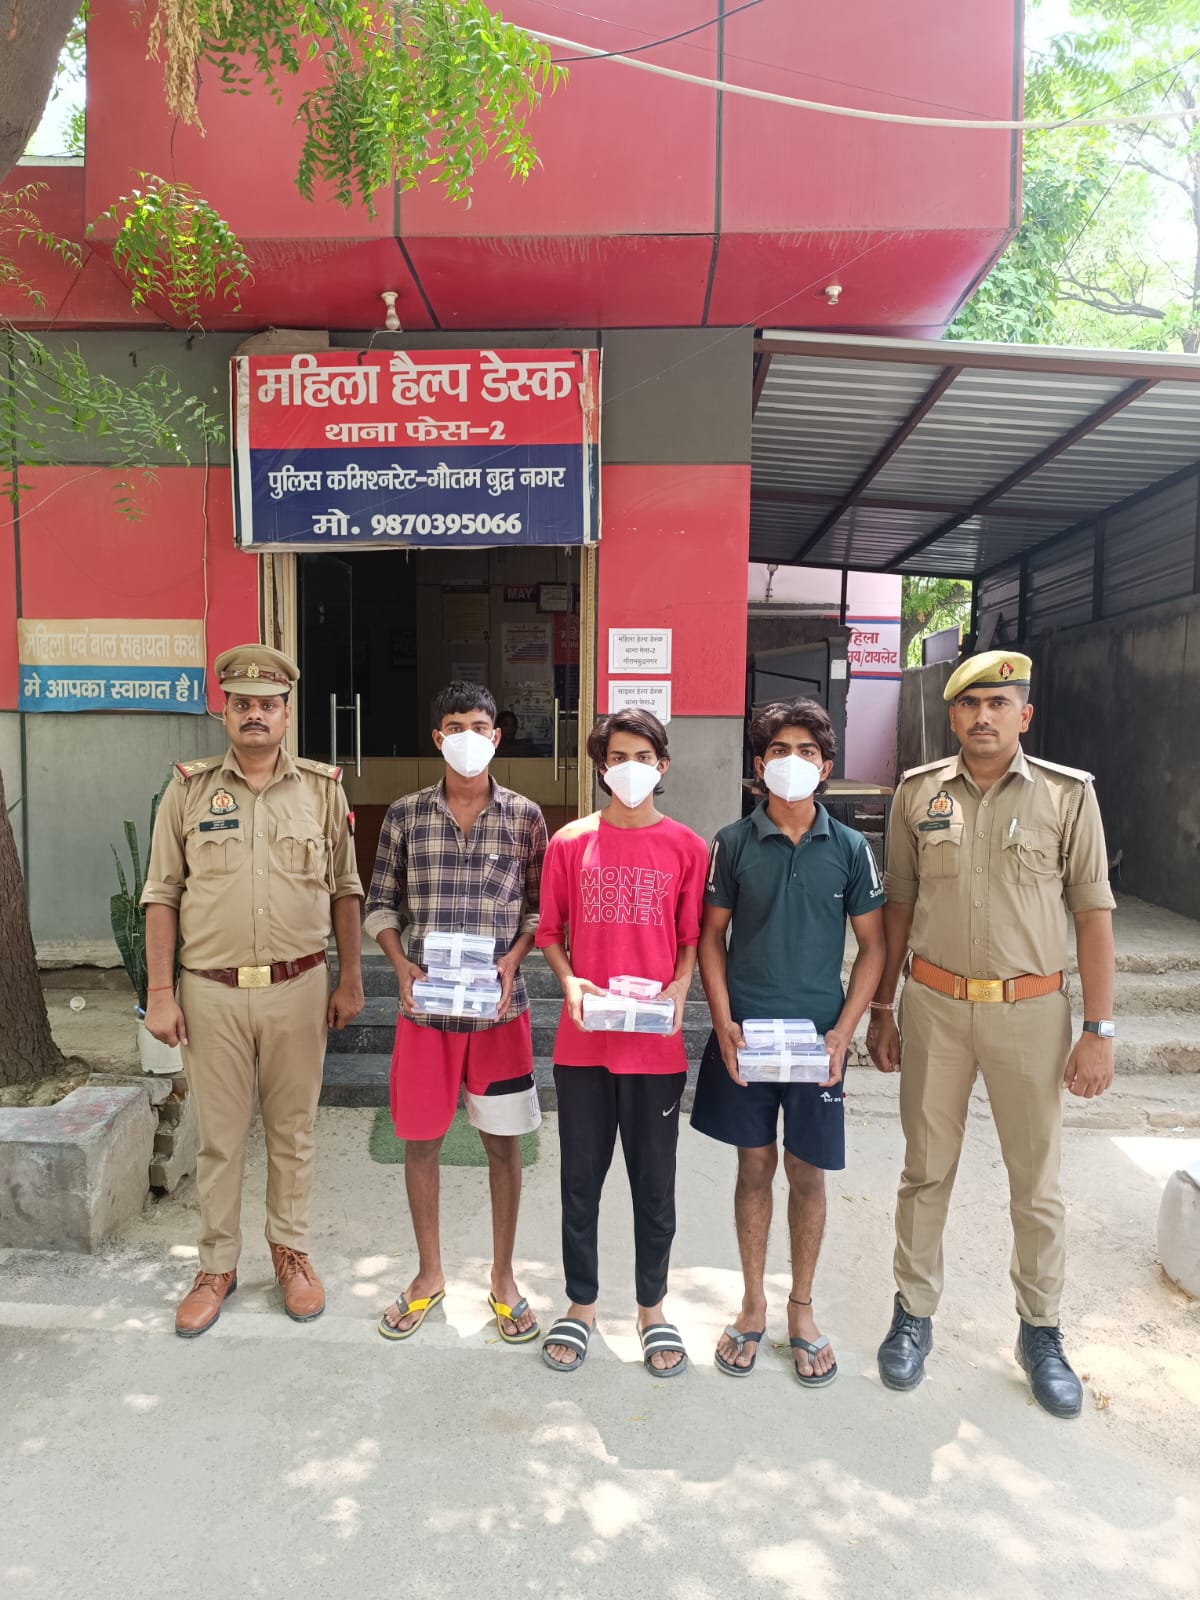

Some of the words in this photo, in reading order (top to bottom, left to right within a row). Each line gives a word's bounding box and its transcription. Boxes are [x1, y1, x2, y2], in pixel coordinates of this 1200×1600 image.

[256, 354, 381, 407] महिला
[389, 350, 471, 406] हैल्प
[480, 350, 575, 403] डेस्क
[325, 422, 398, 443] थाना
[406, 416, 506, 442] फेस-2
[268, 465, 322, 499] पुलिस
[519, 467, 567, 488] नगर
[312, 508, 361, 536] मो.
[371, 513, 522, 536] 9870395066
[507, 587, 532, 600] MAY
[45, 679, 106, 699] आपका
[110, 680, 171, 700] स्वागत
[580, 866, 673, 891] MONEY
[581, 885, 669, 908] MONEY
[583, 904, 665, 926] MONEY
